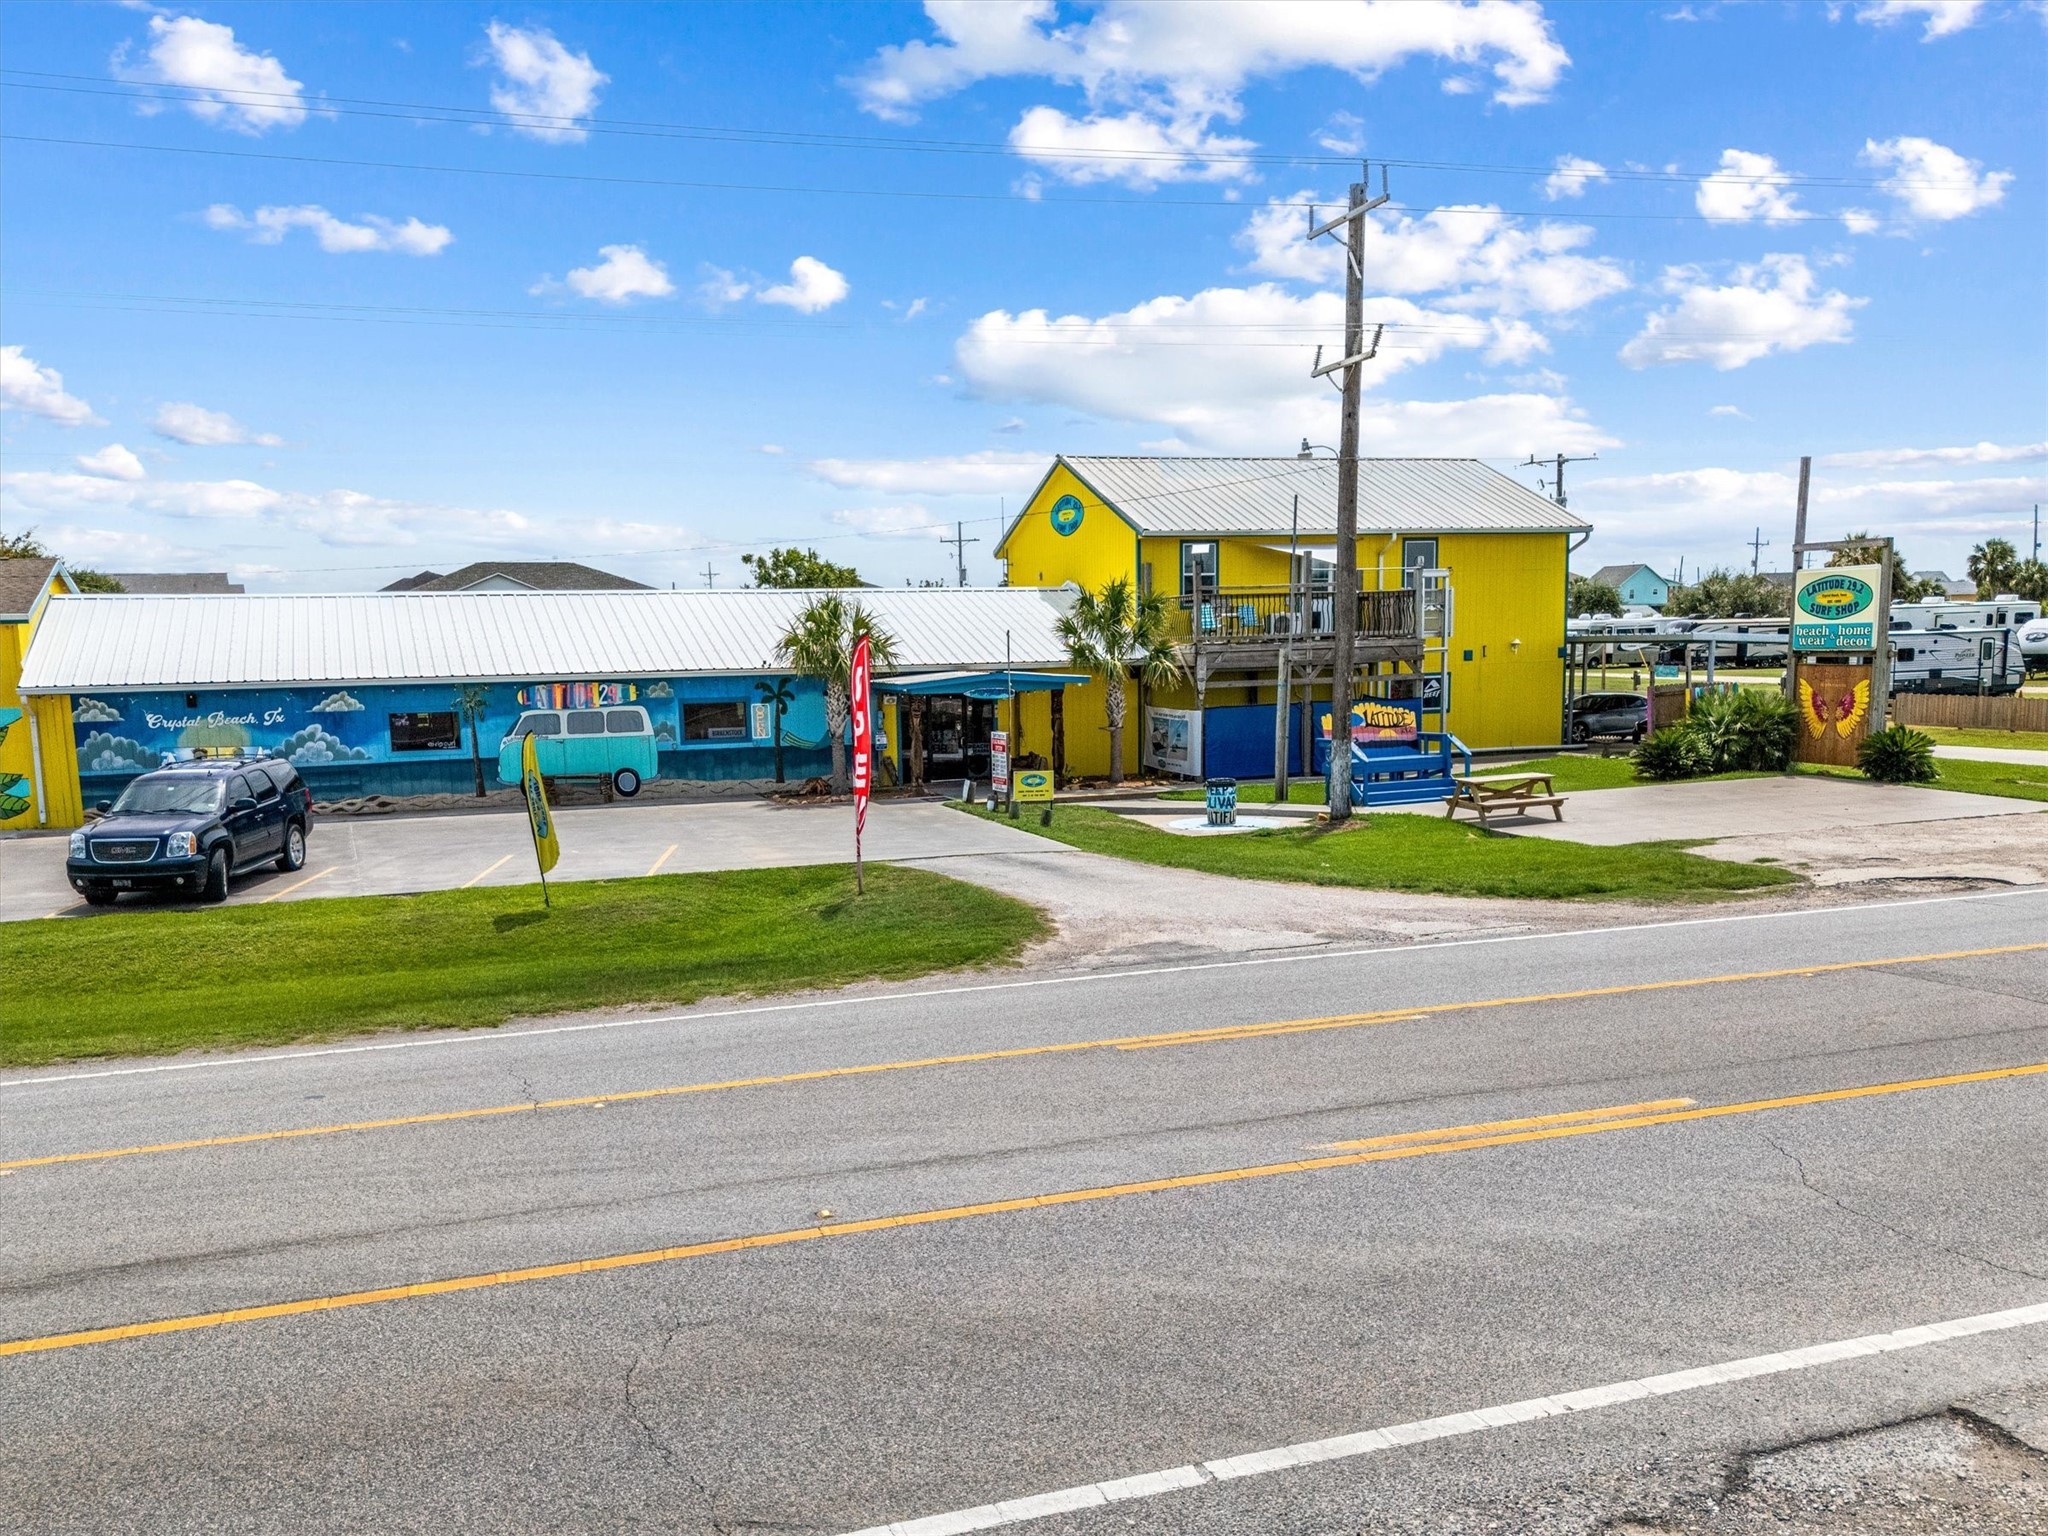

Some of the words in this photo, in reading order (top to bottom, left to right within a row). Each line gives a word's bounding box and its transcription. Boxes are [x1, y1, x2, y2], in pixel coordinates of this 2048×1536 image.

[1805, 579, 1846, 597] LATITUDE
[1847, 580, 1866, 595] 29.2
[1809, 602, 1832, 616] SURF
[1835, 601, 1860, 616] SHOP
[1796, 625, 1830, 637] beach
[1838, 625, 1872, 637] home
[1798, 637, 1827, 646] wear
[1836, 636, 1870, 647] decor
[1423, 690, 1441, 699] REEF
[146, 713, 202, 732] Crystal
[263, 707, 286, 726] Tx
[1363, 710, 1414, 728] LATITUDE
